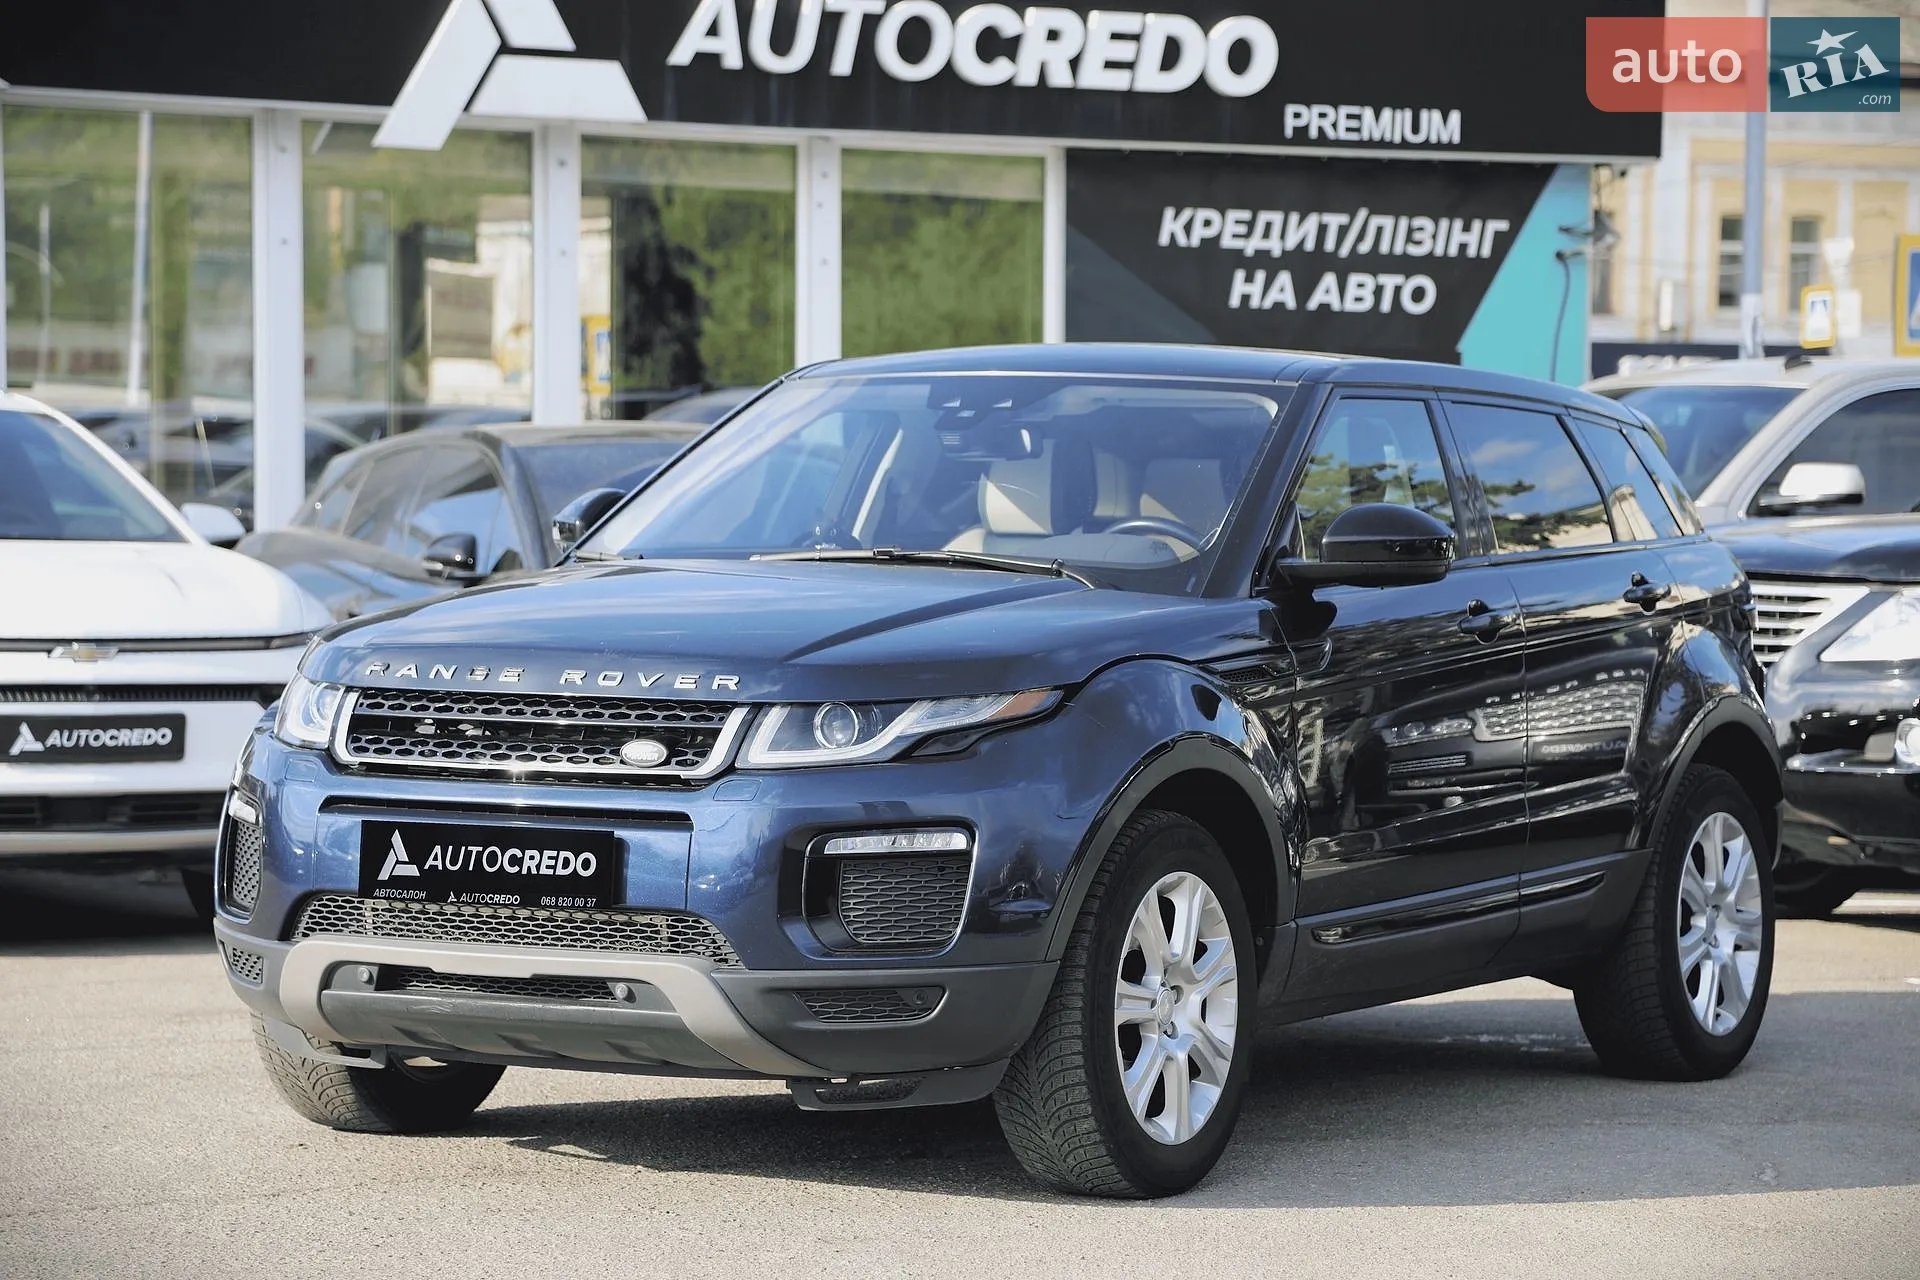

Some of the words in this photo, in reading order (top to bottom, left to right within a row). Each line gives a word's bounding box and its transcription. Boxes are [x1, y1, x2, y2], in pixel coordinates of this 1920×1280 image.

[665, 0, 1280, 98] AUTOCREDO
[1283, 103, 1462, 145] PREMIUM
[1157, 207, 1511, 259] КРЕДИТ/ЛІЗІНГ
[1228, 269, 1298, 311] НА
[1307, 272, 1438, 315] АВТО
[365, 661, 525, 684] RANGE
[559, 669, 742, 691] ROVER
[45, 727, 173, 748] AUTOCREDO
[424, 844, 597, 877] AUTOCREDO
[373, 888, 427, 900] АВТОСАЛОН
[459, 893, 521, 905] AUTOCREDO
[540, 896, 556, 907] 068
[557, 897, 573, 907] 820
[574, 898, 586, 908] 00
[586, 898, 597, 908] 37
